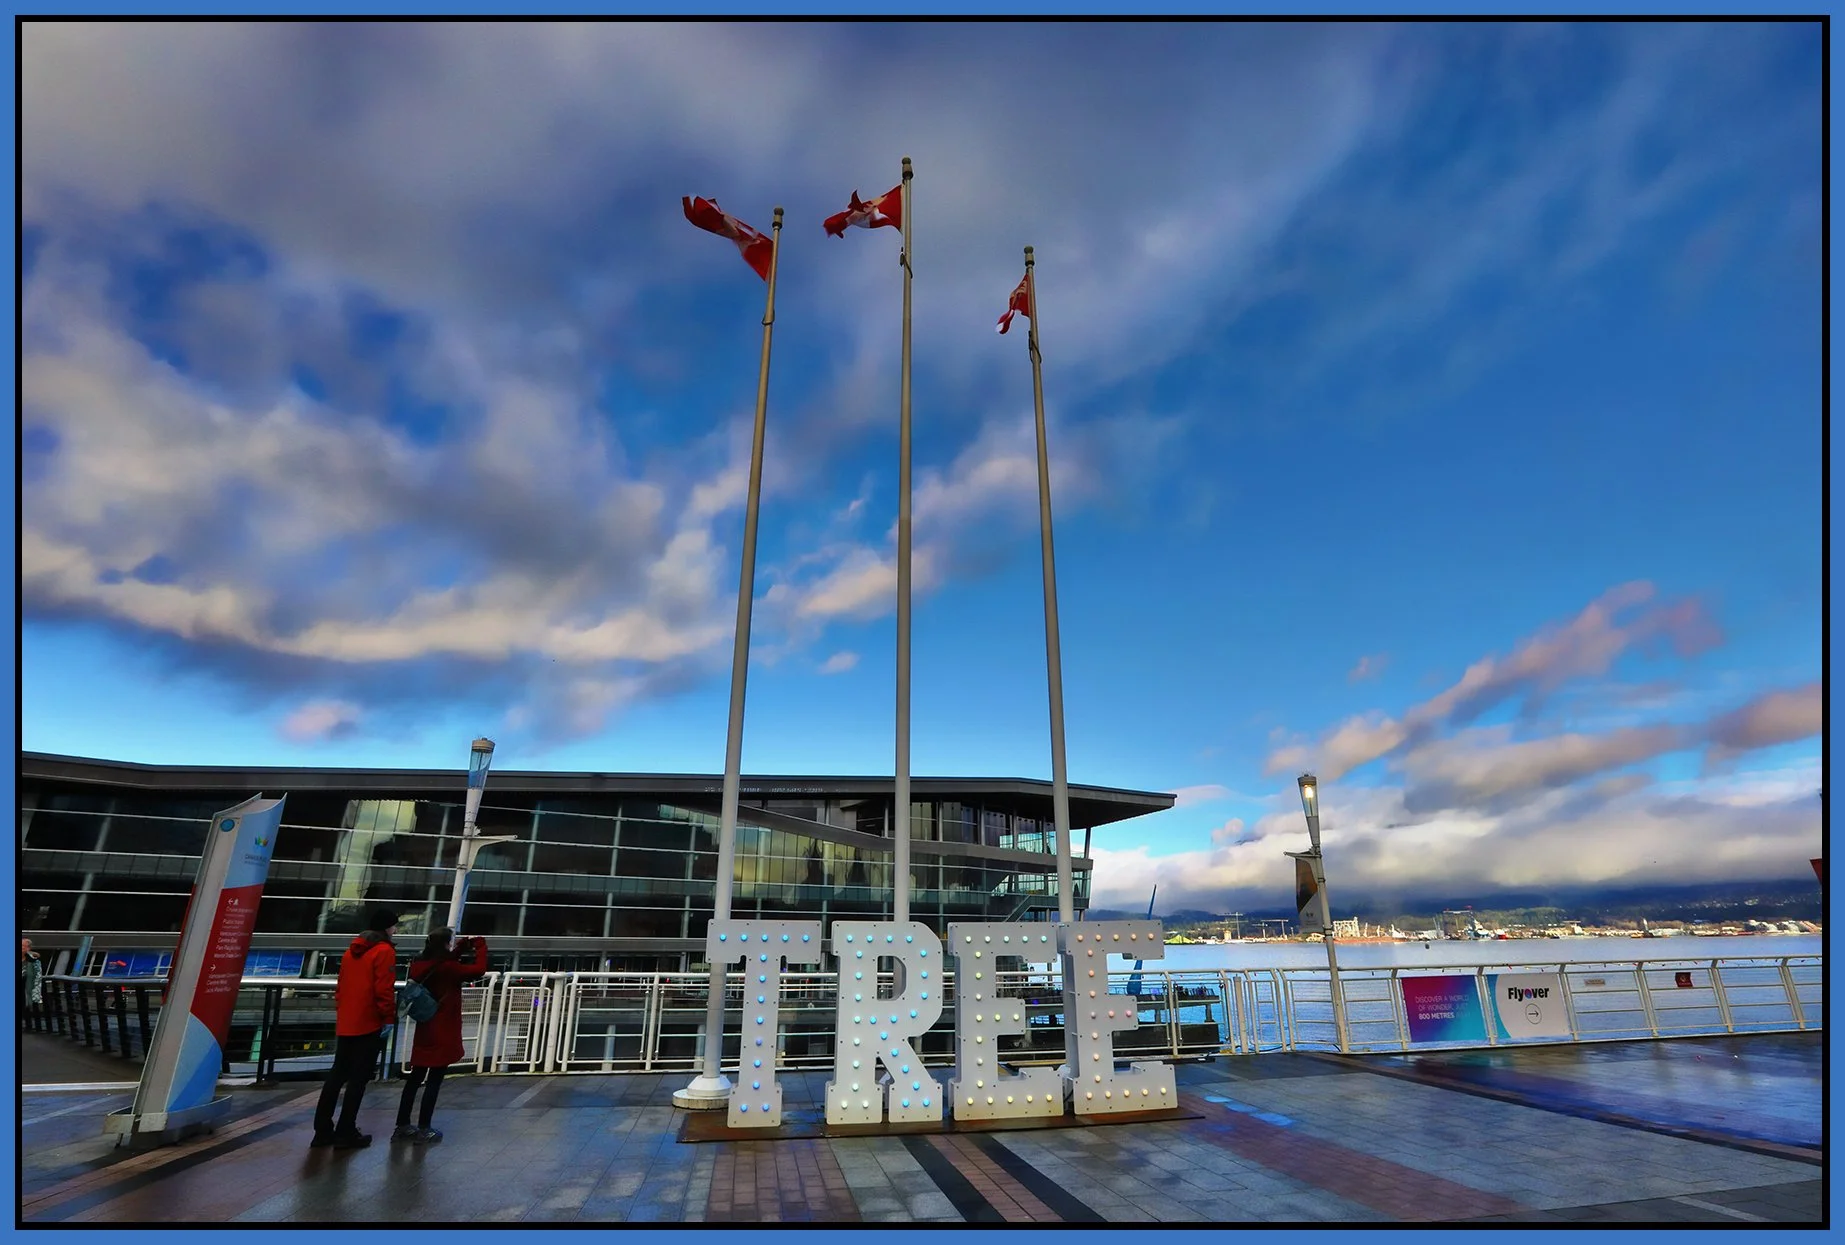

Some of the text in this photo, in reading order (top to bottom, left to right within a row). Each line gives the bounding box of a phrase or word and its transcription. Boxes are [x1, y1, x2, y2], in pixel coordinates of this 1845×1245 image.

[1415, 995, 1442, 1003] DISCOVER
[1508, 987, 1549, 1002] Flyover
[706, 919, 1178, 1127] TREE
